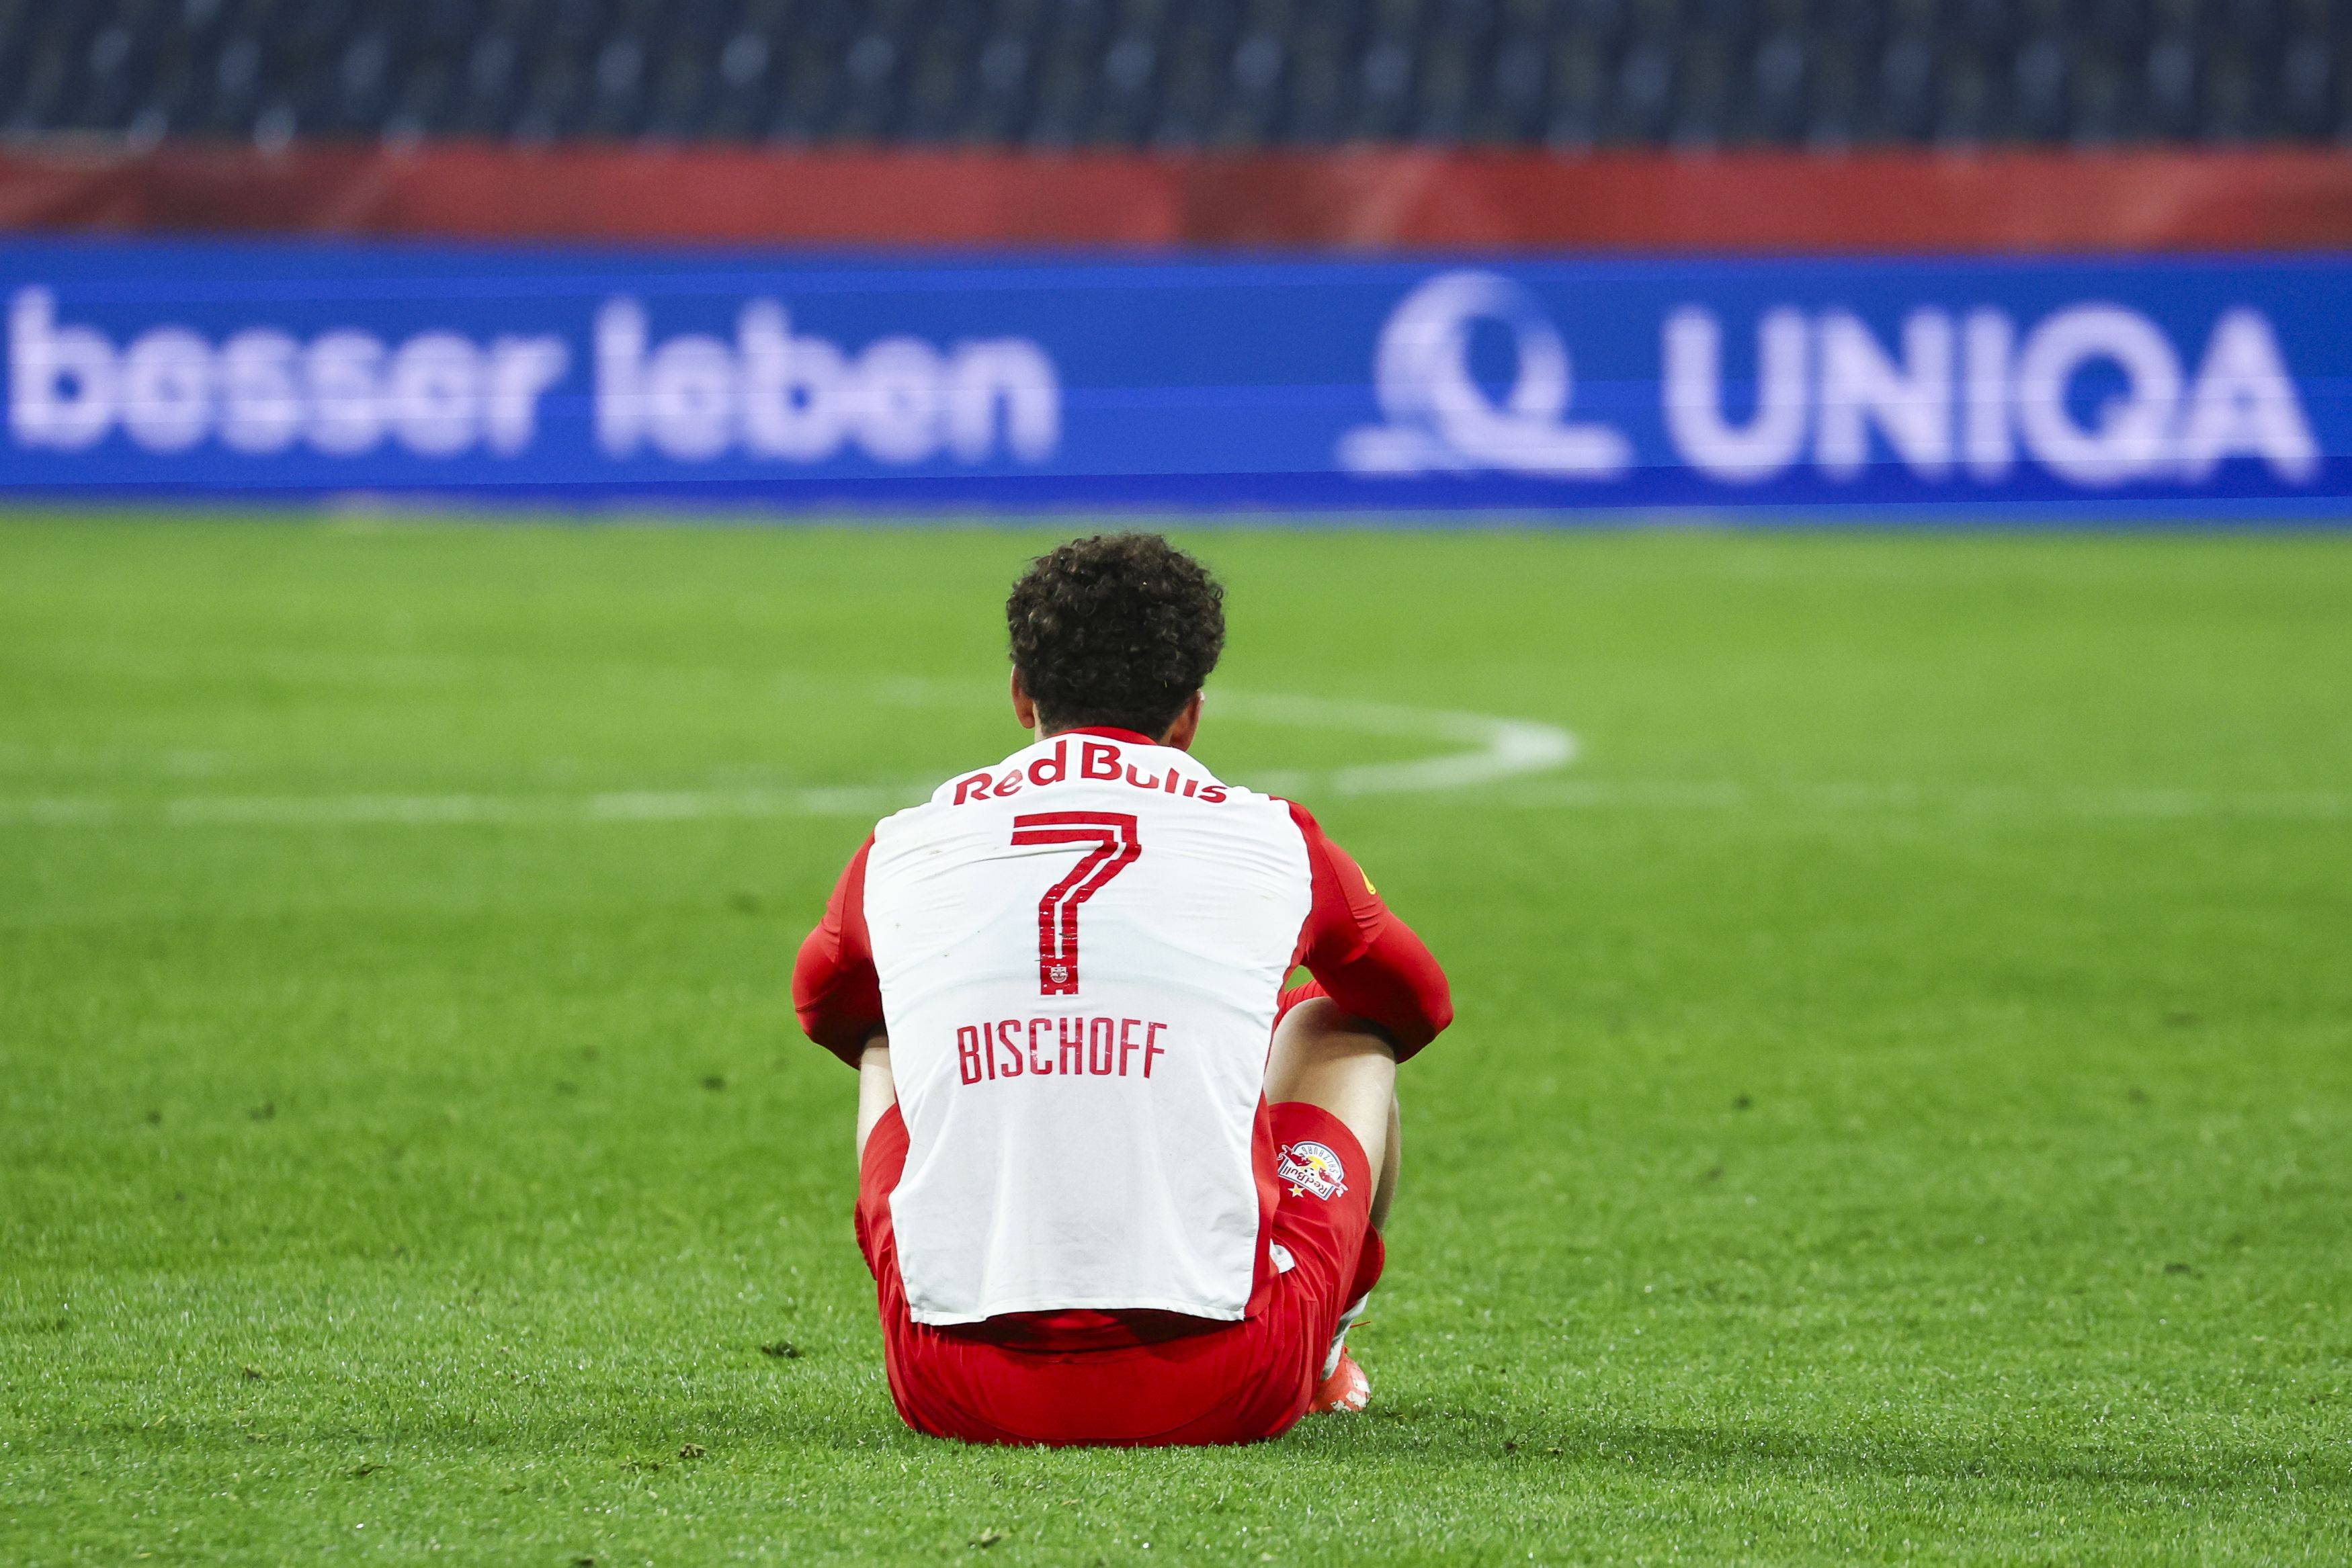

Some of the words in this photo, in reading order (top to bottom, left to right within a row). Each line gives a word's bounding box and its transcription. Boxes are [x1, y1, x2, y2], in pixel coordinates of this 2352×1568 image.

[9, 286, 569, 453] besser
[595, 298, 1060, 462] leben
[1663, 306, 2318, 485] UNIQA
[954, 740, 1066, 805] Red
[1081, 742, 1227, 803] Bulls
[1011, 812, 1142, 995] 7
[957, 1017, 1167, 1086] BISCHOFF
